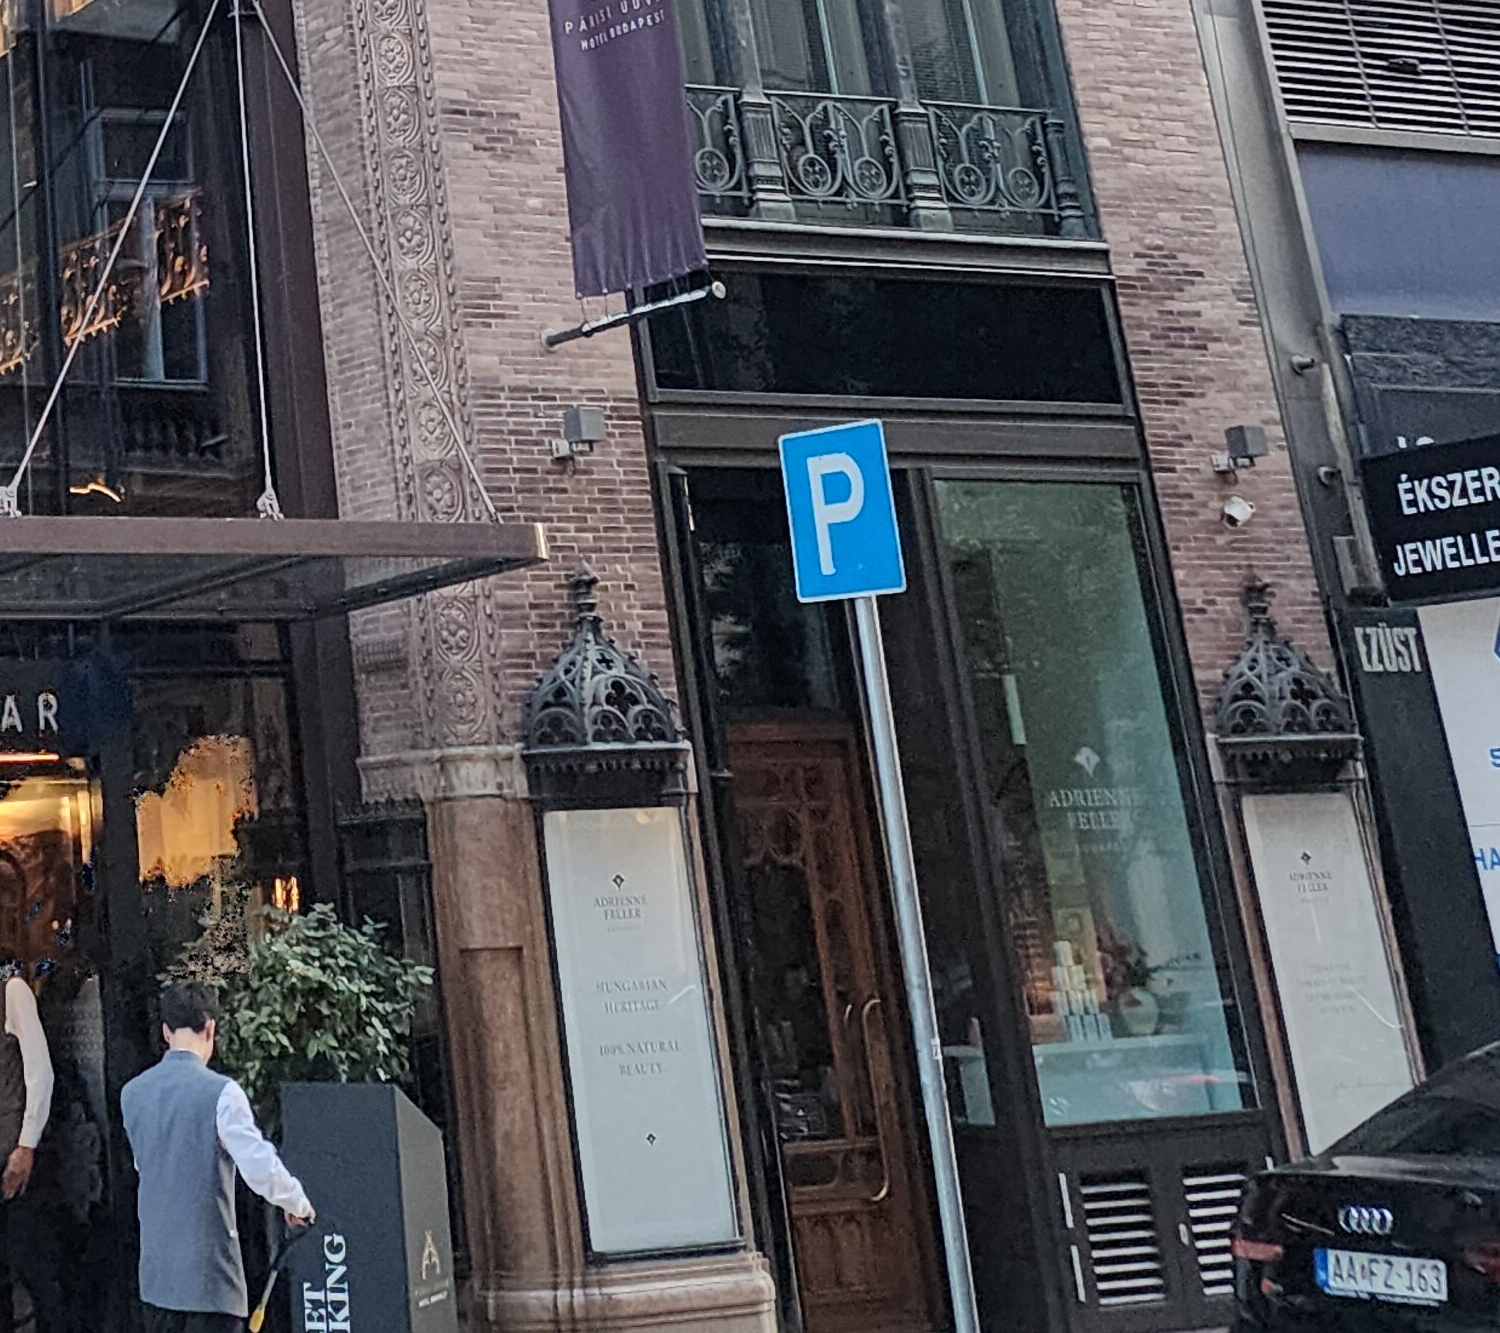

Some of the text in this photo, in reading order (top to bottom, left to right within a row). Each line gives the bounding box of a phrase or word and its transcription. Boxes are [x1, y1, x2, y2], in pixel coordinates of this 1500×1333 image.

[806, 451, 865, 576] P
[1393, 530, 1500, 576] JEWELLE
[593, 895, 647, 909] ADRIENNE
[603, 907, 642, 921] FELLER
[596, 978, 668, 994] HUNGARIAN
[604, 999, 660, 1015] HERITAGE
[627, 1039, 681, 1055] NATURAL
[323, 1233, 350, 1333] KING
[303, 1282, 328, 1333] ET
